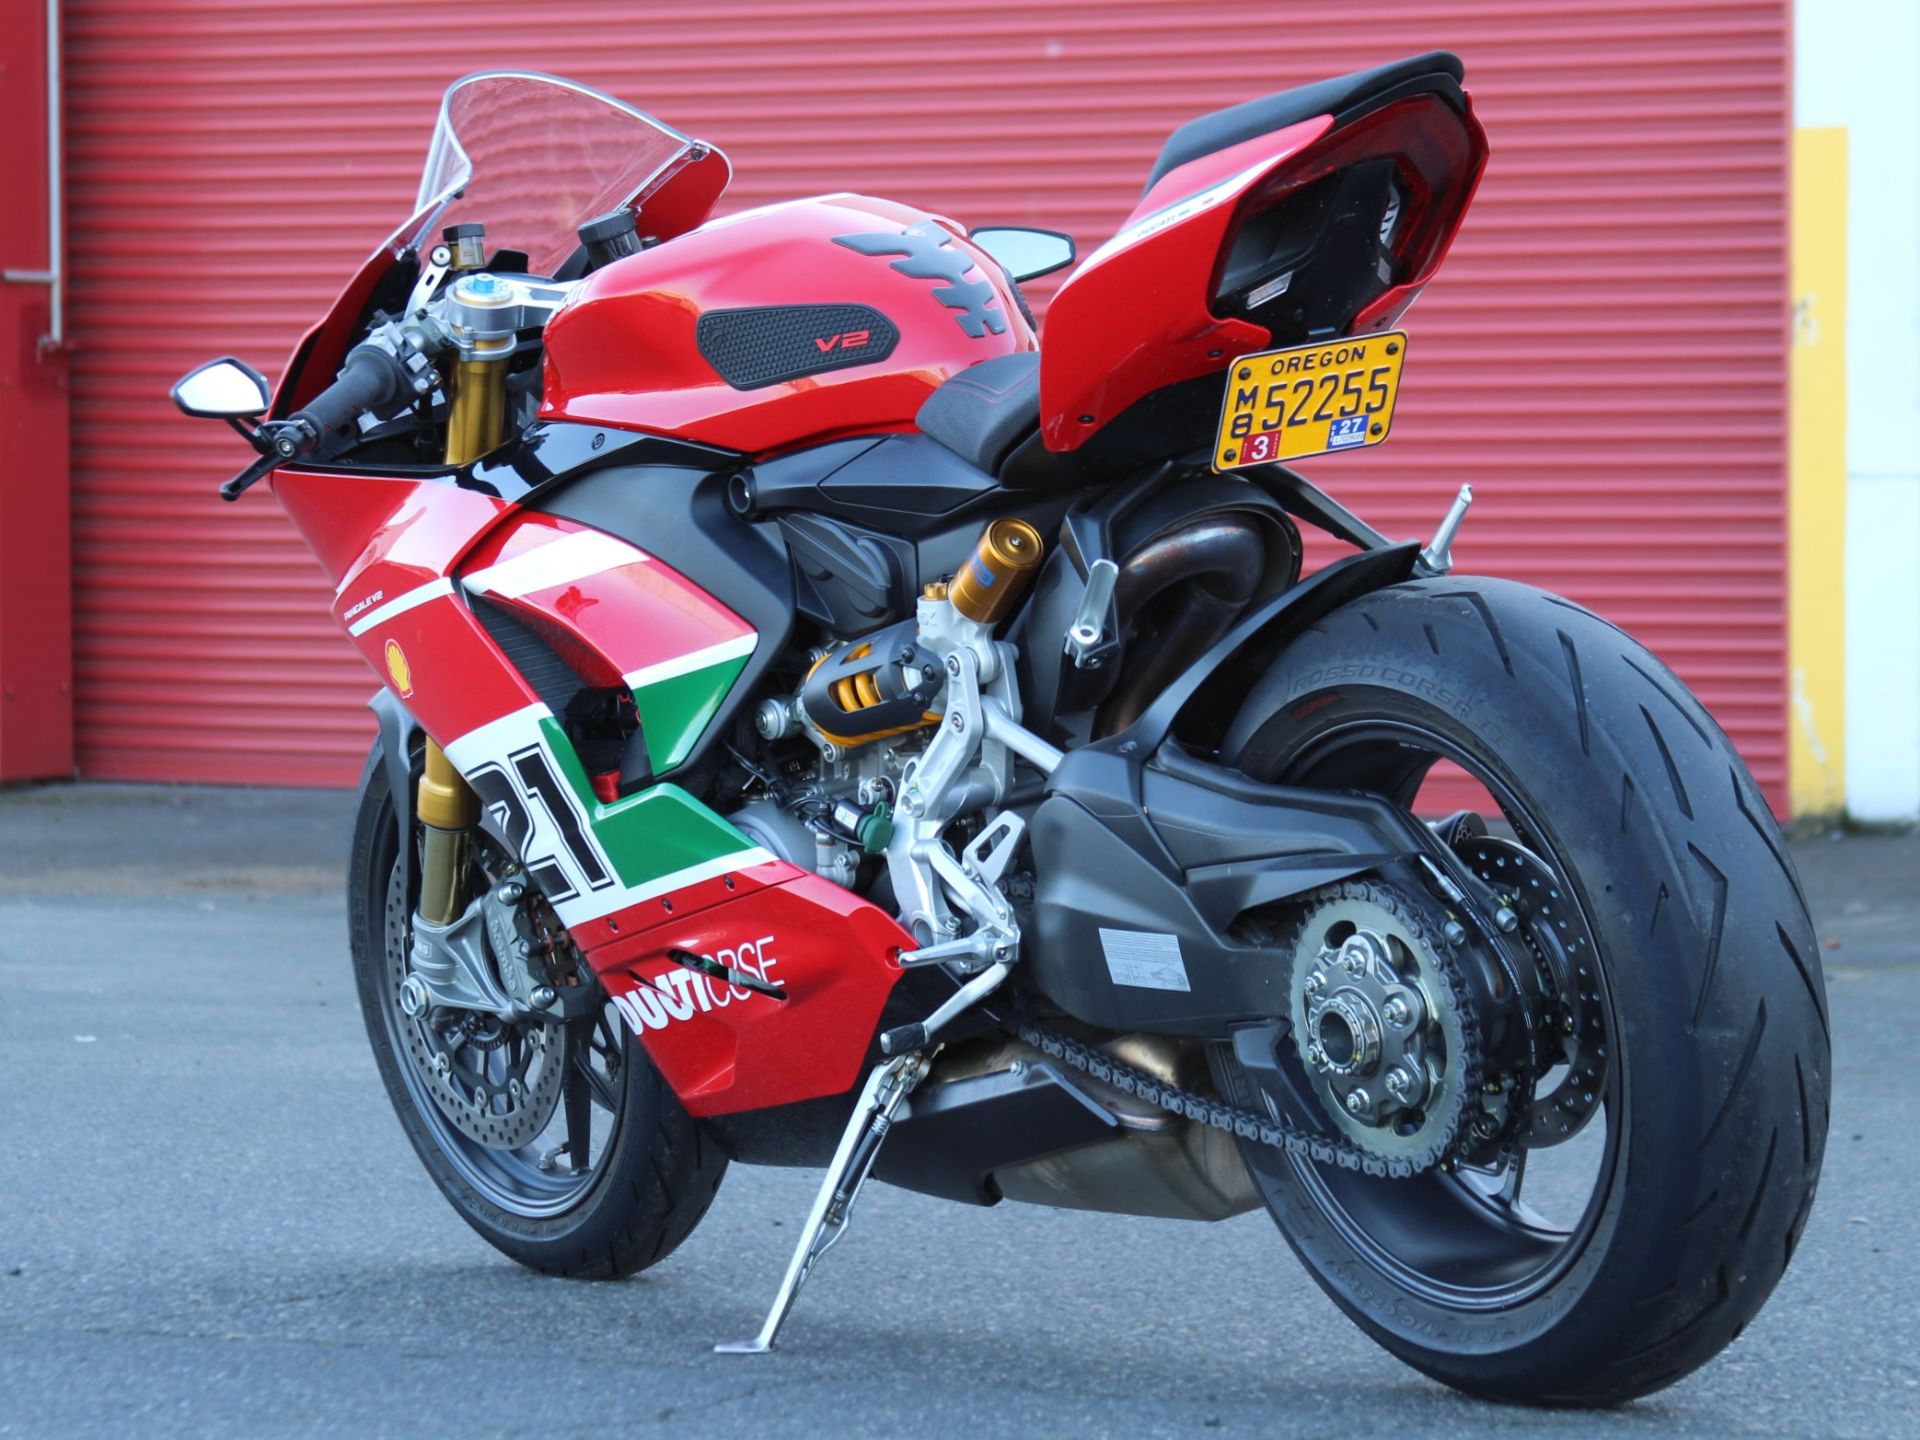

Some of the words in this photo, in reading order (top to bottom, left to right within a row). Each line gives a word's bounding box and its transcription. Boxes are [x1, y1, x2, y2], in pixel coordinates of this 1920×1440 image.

[815, 330, 870, 352] V2
[1271, 345, 1366, 375] OREGON
[1262, 366, 1391, 431] 52255
[1339, 418, 1363, 434] 27
[1251, 435, 1270, 459] 3
[464, 742, 615, 906] 21
